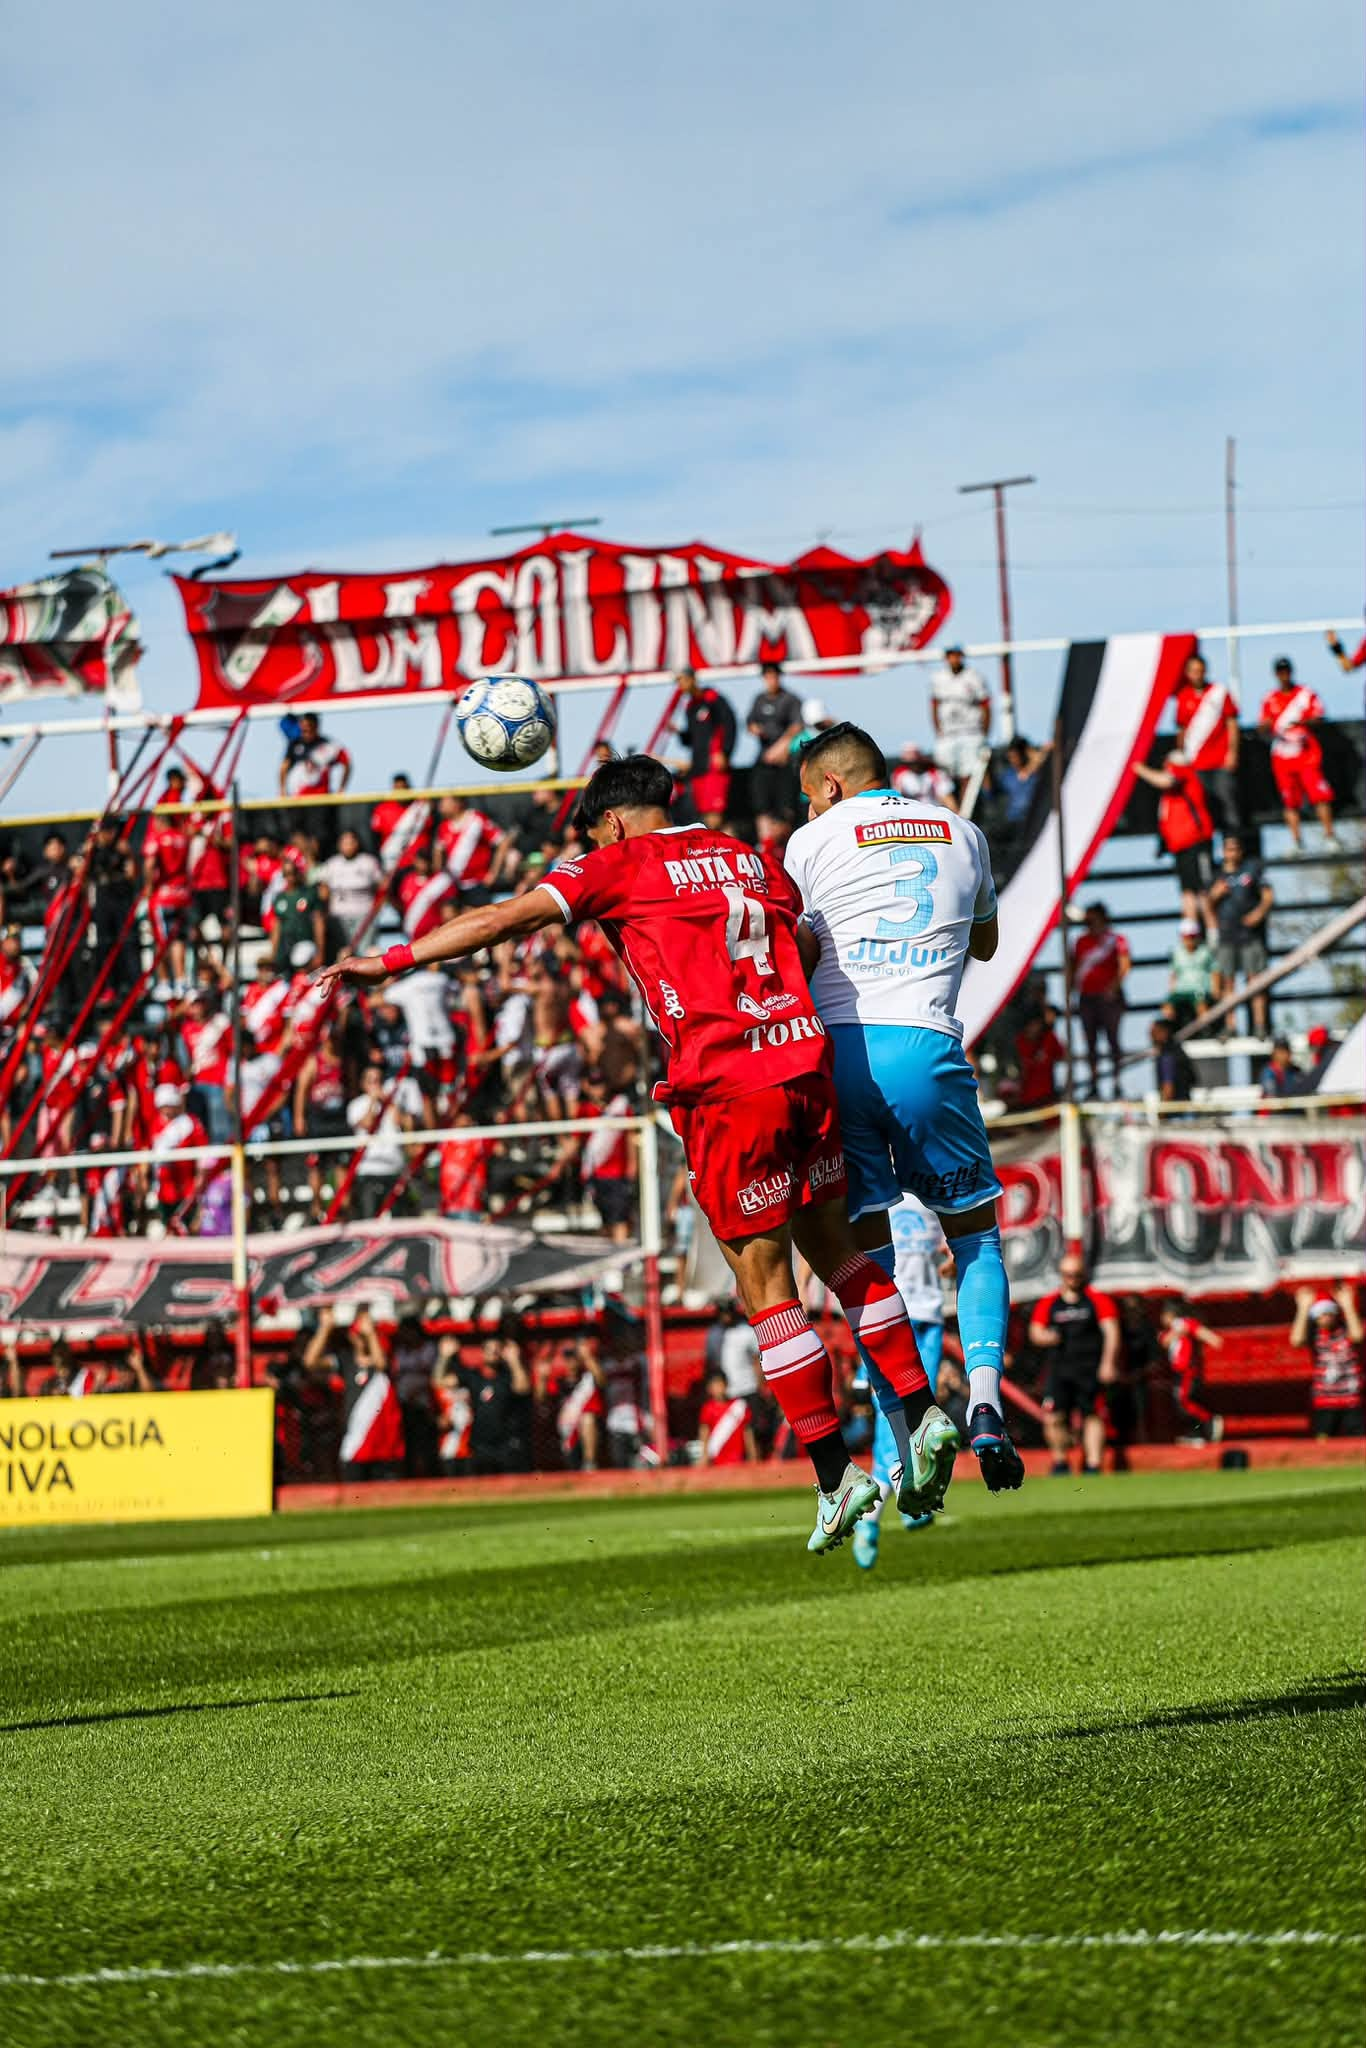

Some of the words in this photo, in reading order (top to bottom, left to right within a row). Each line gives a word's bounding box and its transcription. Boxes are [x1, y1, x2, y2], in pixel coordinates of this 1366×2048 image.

[862, 822, 945, 841] COMODIN
[664, 855, 735, 885] RUTA
[736, 853, 764, 880] 40
[875, 845, 938, 938] 3
[721, 886, 776, 975] 4
[0, 1460, 74, 1494] IVA
